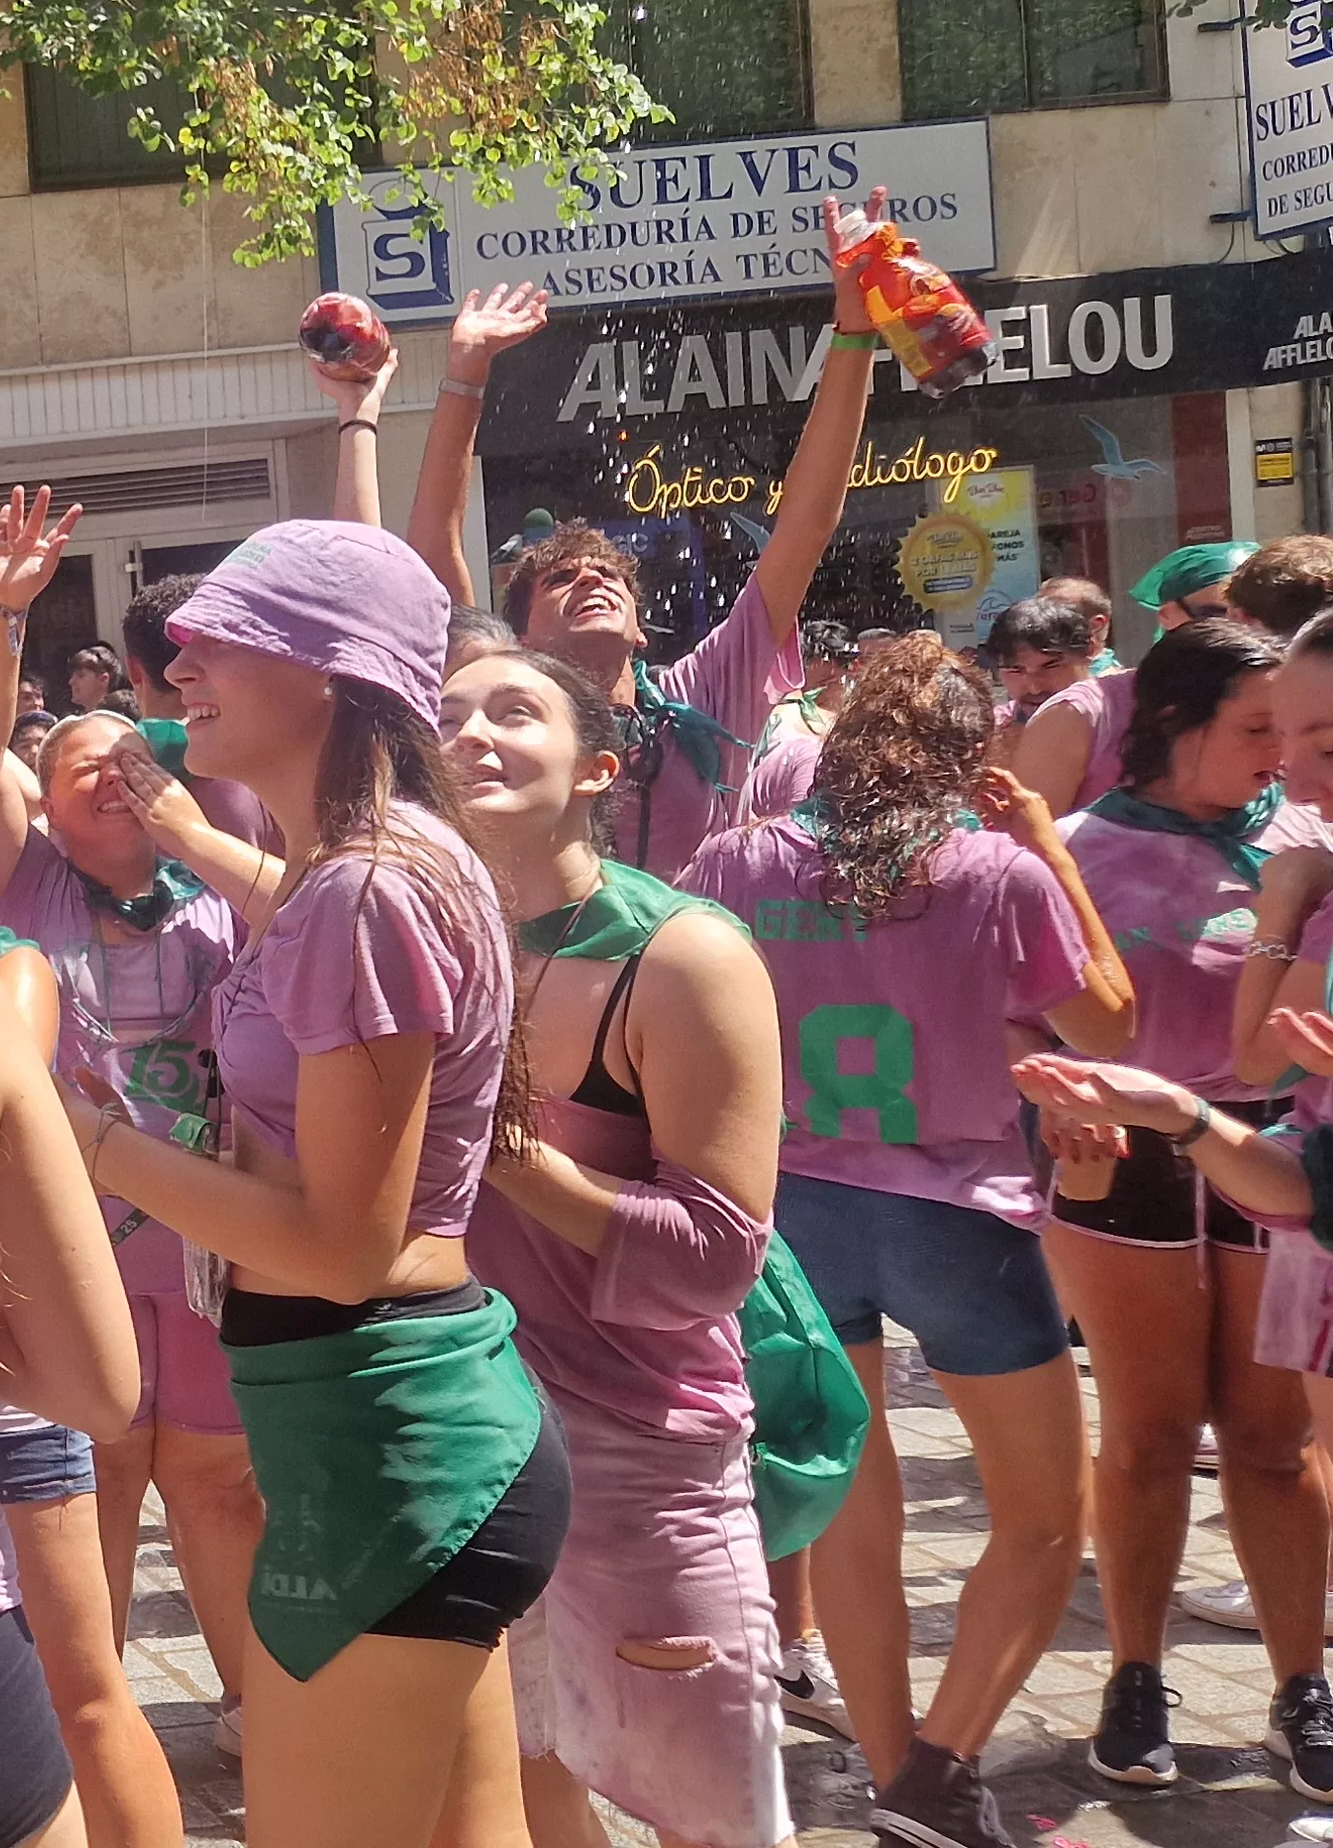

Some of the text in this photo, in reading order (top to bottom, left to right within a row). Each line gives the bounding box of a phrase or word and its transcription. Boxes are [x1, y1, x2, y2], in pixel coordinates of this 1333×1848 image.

[569, 140, 859, 212] SUELVES
[1267, 193, 1289, 218] DE
[477, 207, 716, 260] CORREDURÍA
[730, 208, 778, 239] DE
[541, 249, 723, 298] ASESORÍA
[1293, 311, 1333, 340] ALA
[556, 324, 805, 423] ALAIN
[627, 443, 756, 520] Óptico
[845, 435, 999, 503] diólogo
[988, 528, 1021, 540] AREJA
[119, 1218, 138, 1235] 25
